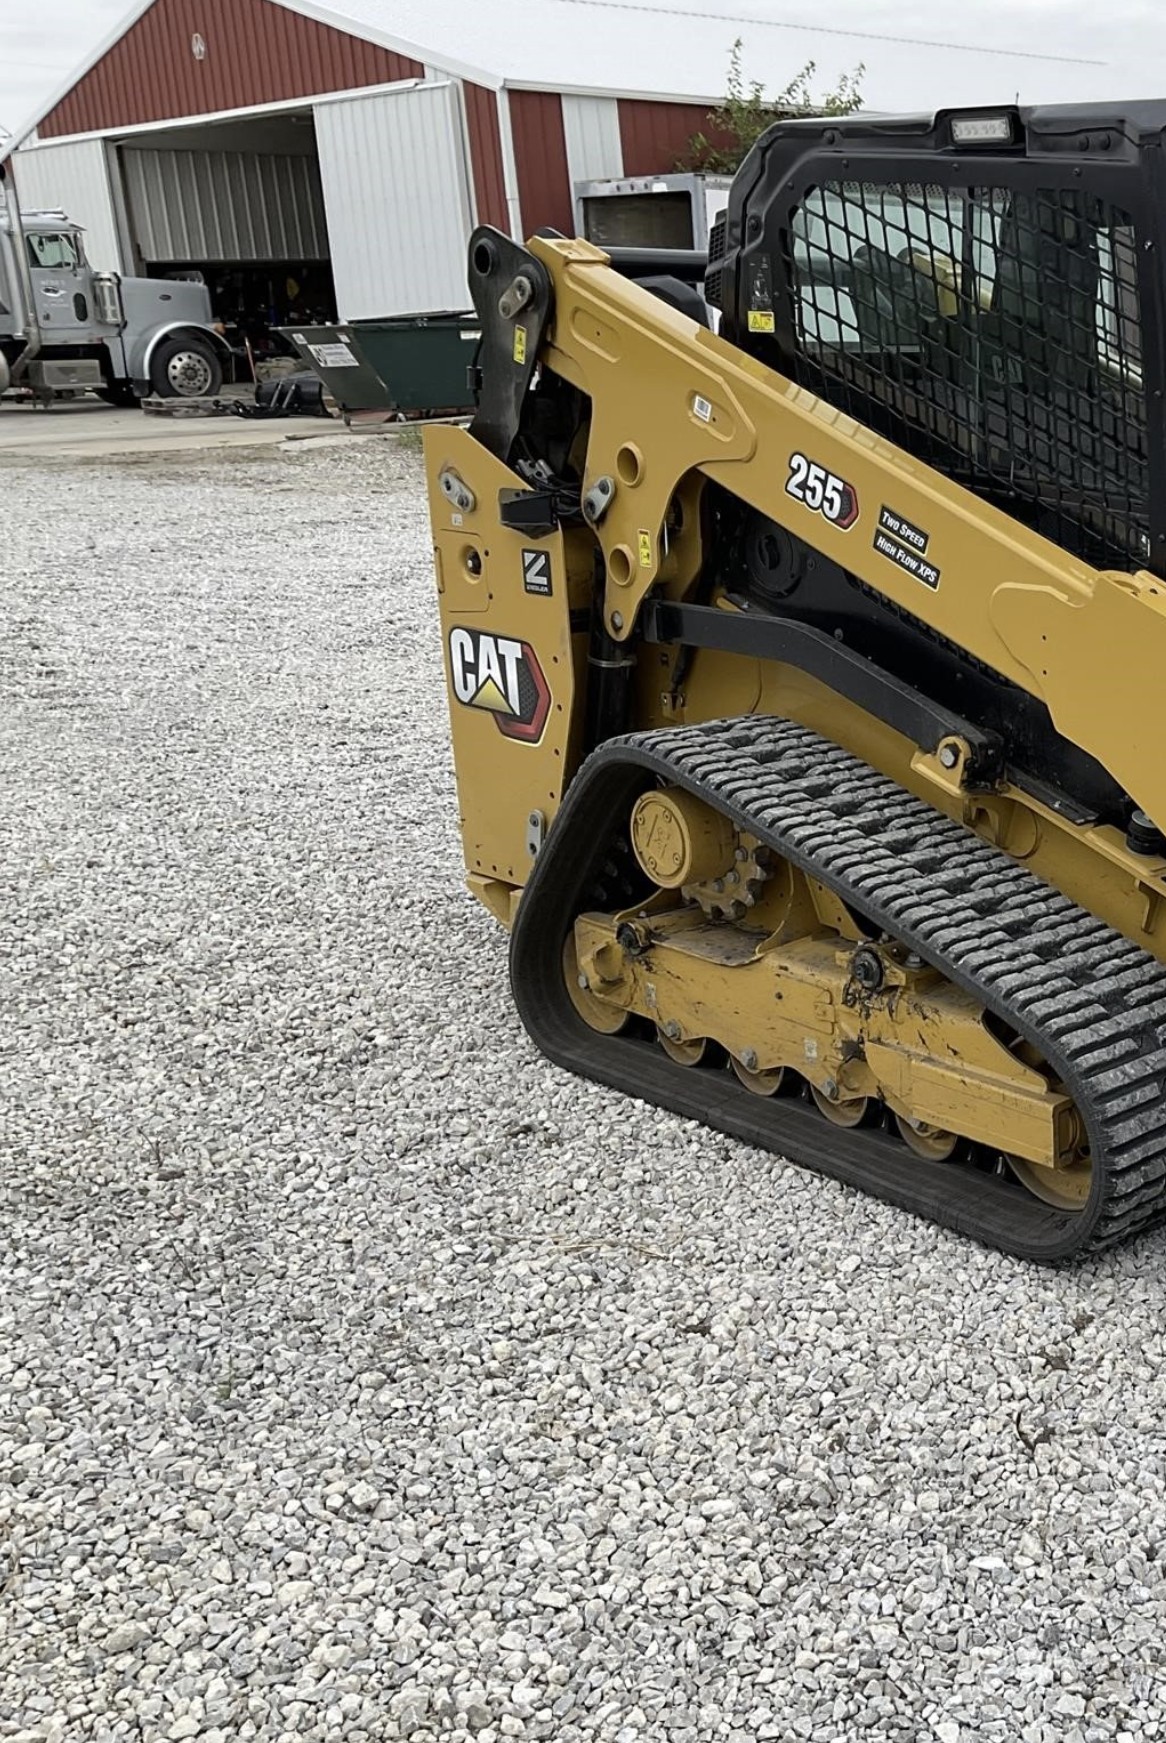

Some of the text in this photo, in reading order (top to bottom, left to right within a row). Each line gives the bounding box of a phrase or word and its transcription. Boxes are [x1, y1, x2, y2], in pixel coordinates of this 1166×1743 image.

[786, 453, 844, 519] 255
[917, 565, 937, 583] XPS
[450, 628, 523, 716] CAT
